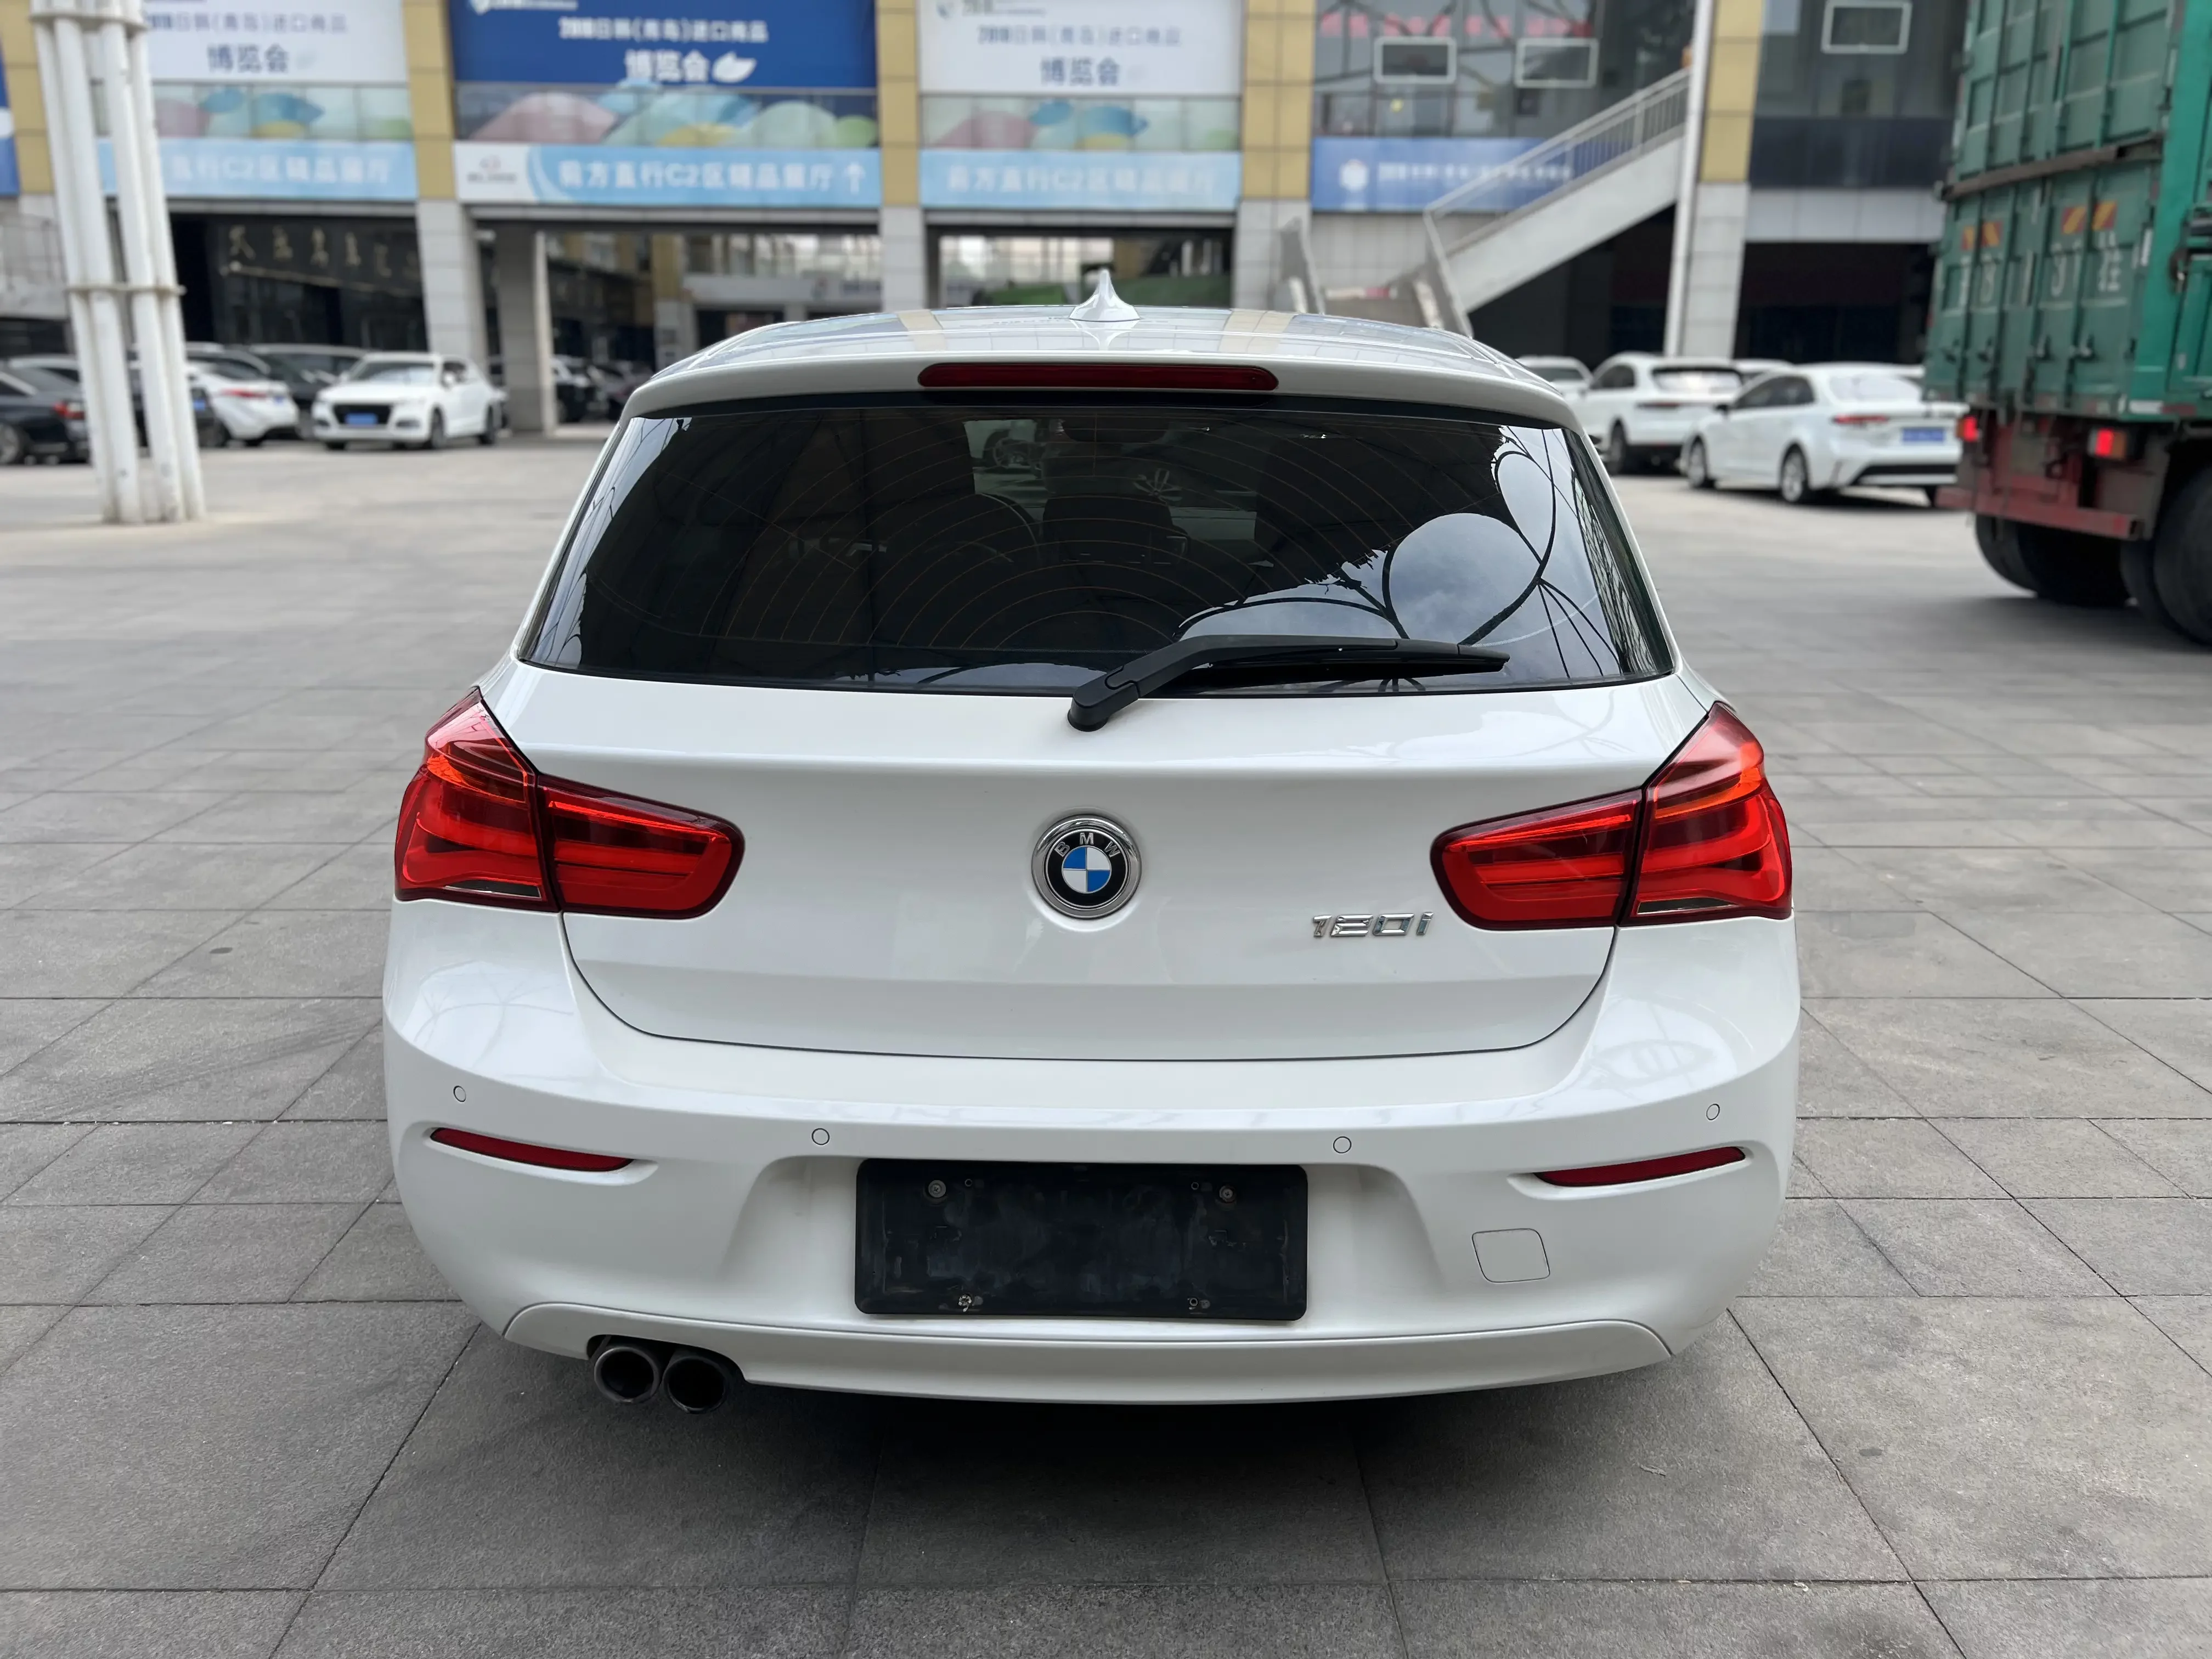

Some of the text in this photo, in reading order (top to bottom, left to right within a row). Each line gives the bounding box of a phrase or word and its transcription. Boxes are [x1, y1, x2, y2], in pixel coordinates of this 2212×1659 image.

[207, 43, 290, 74] 博览会
[625, 48, 710, 82] 博览会
[1040, 57, 1120, 87] 博览会
[1054, 832, 1121, 857] BMW
[1313, 912, 1434, 936] 120i
